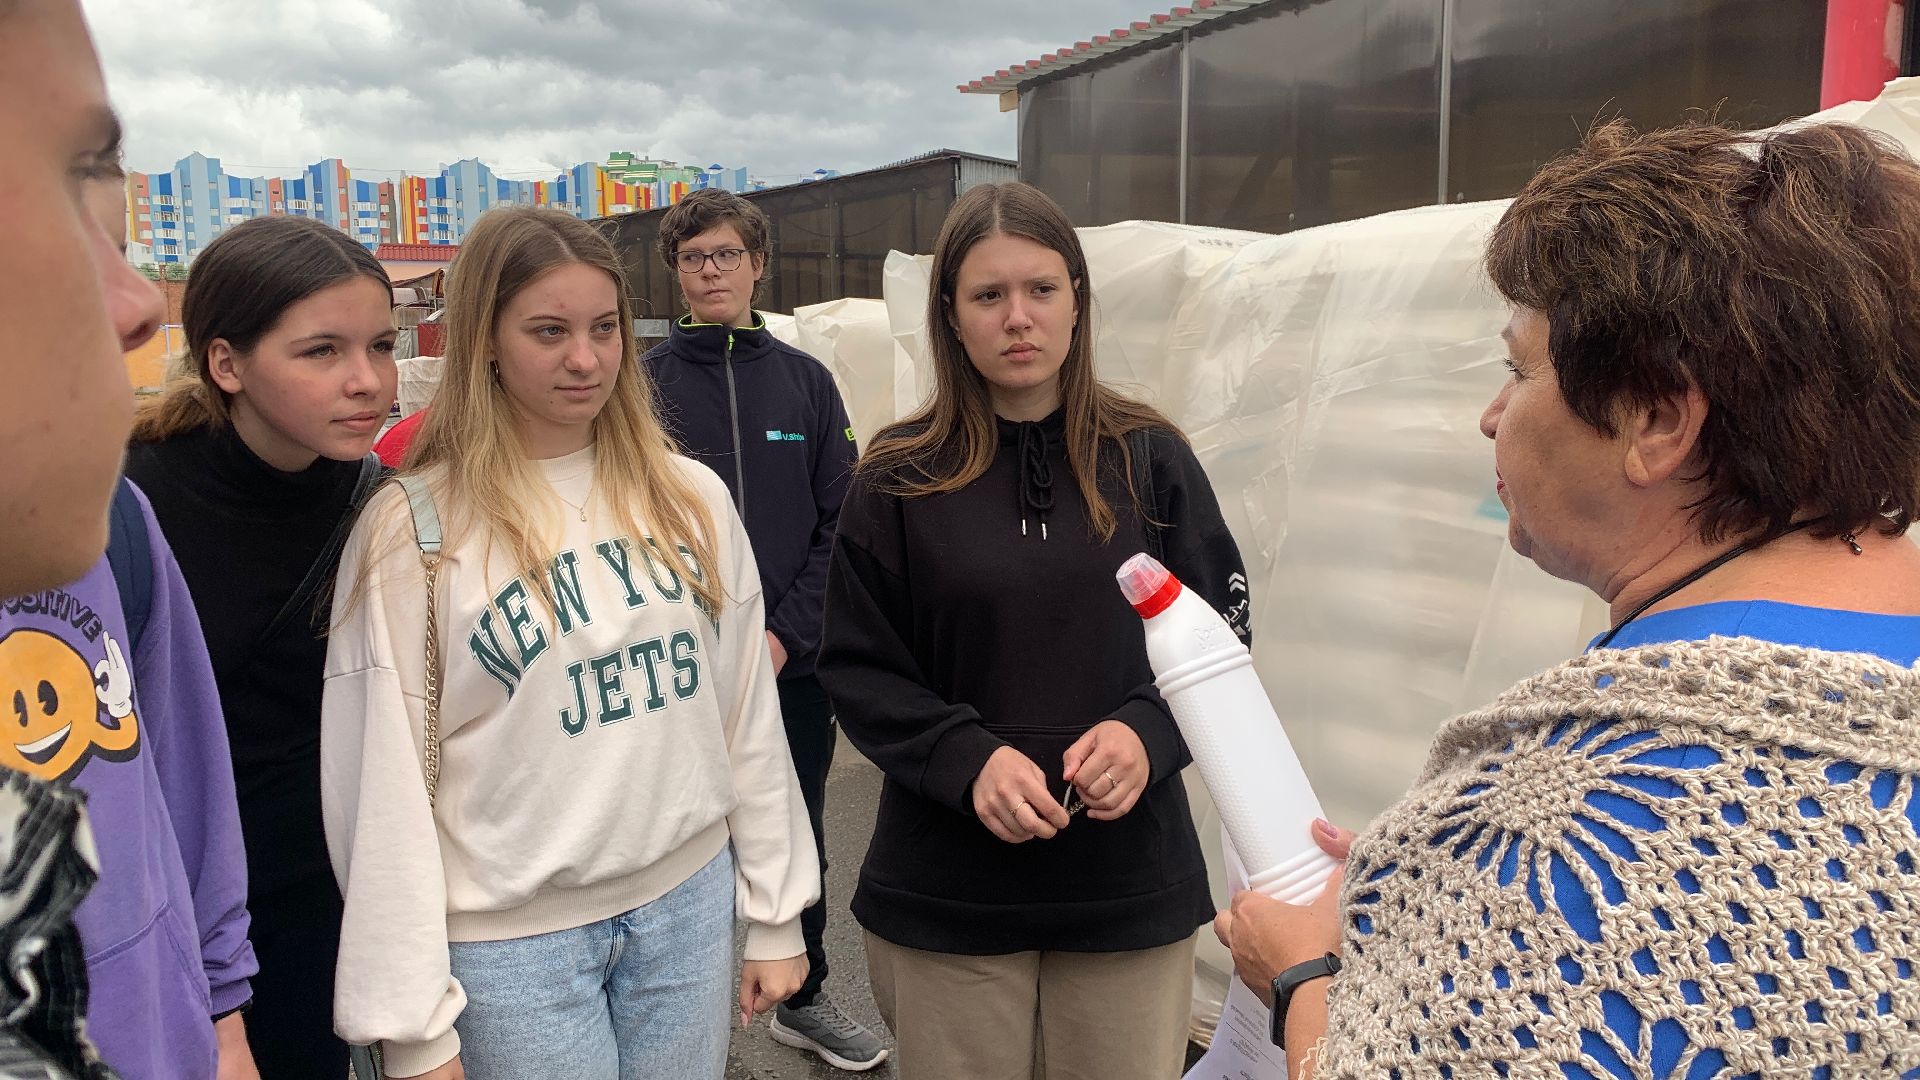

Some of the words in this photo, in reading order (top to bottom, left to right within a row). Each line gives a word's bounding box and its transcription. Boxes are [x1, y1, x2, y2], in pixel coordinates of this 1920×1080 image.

[0, 588, 103, 643] OSITIVE
[468, 549, 592, 701] NEW
[559, 629, 700, 738] JETS
